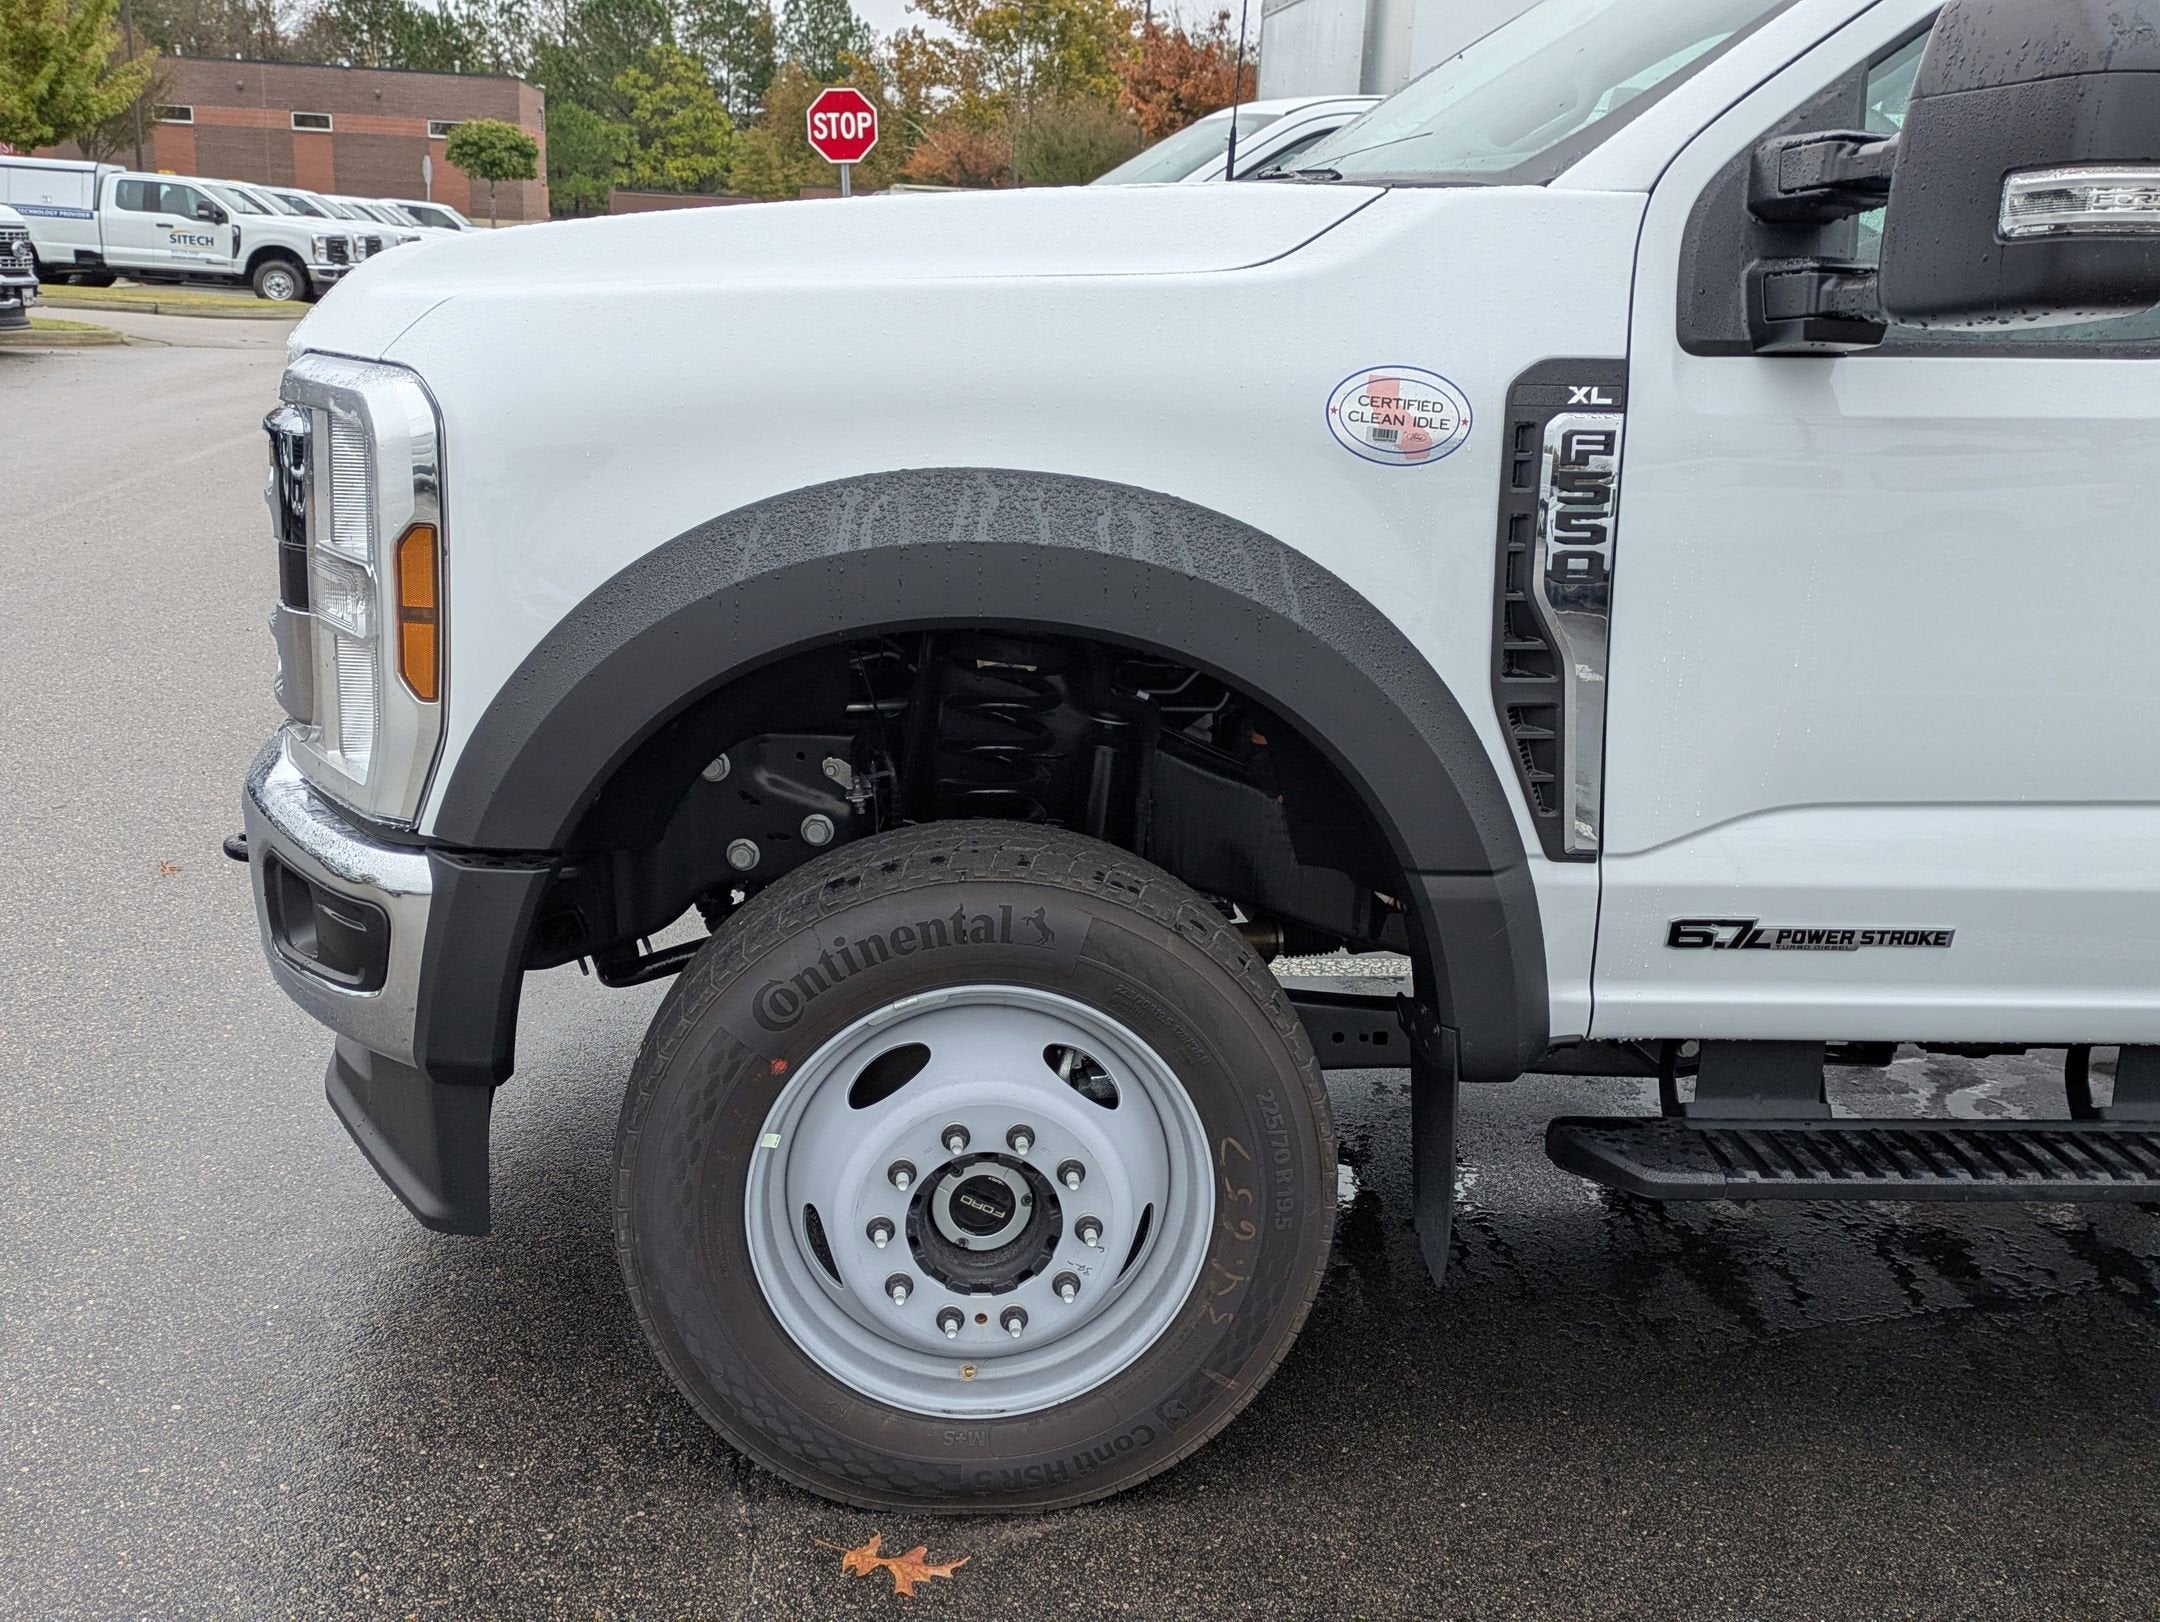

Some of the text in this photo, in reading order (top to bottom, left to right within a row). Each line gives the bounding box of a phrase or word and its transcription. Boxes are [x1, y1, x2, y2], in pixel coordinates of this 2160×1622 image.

[813, 111, 872, 140] STOP
[169, 233, 215, 247] SITECH
[1358, 395, 1444, 413] CERTIFIED
[1567, 386, 1612, 405] XL
[1348, 410, 1451, 430] CLEAN IDLE
[1665, 917, 1949, 949] 6.7L POWER STROKE
[752, 904, 1013, 1032] Continental
[960, 1194, 1006, 1219] FORD
[943, 1430, 986, 1447] M+S
[1073, 1423, 1156, 1477] Conti
